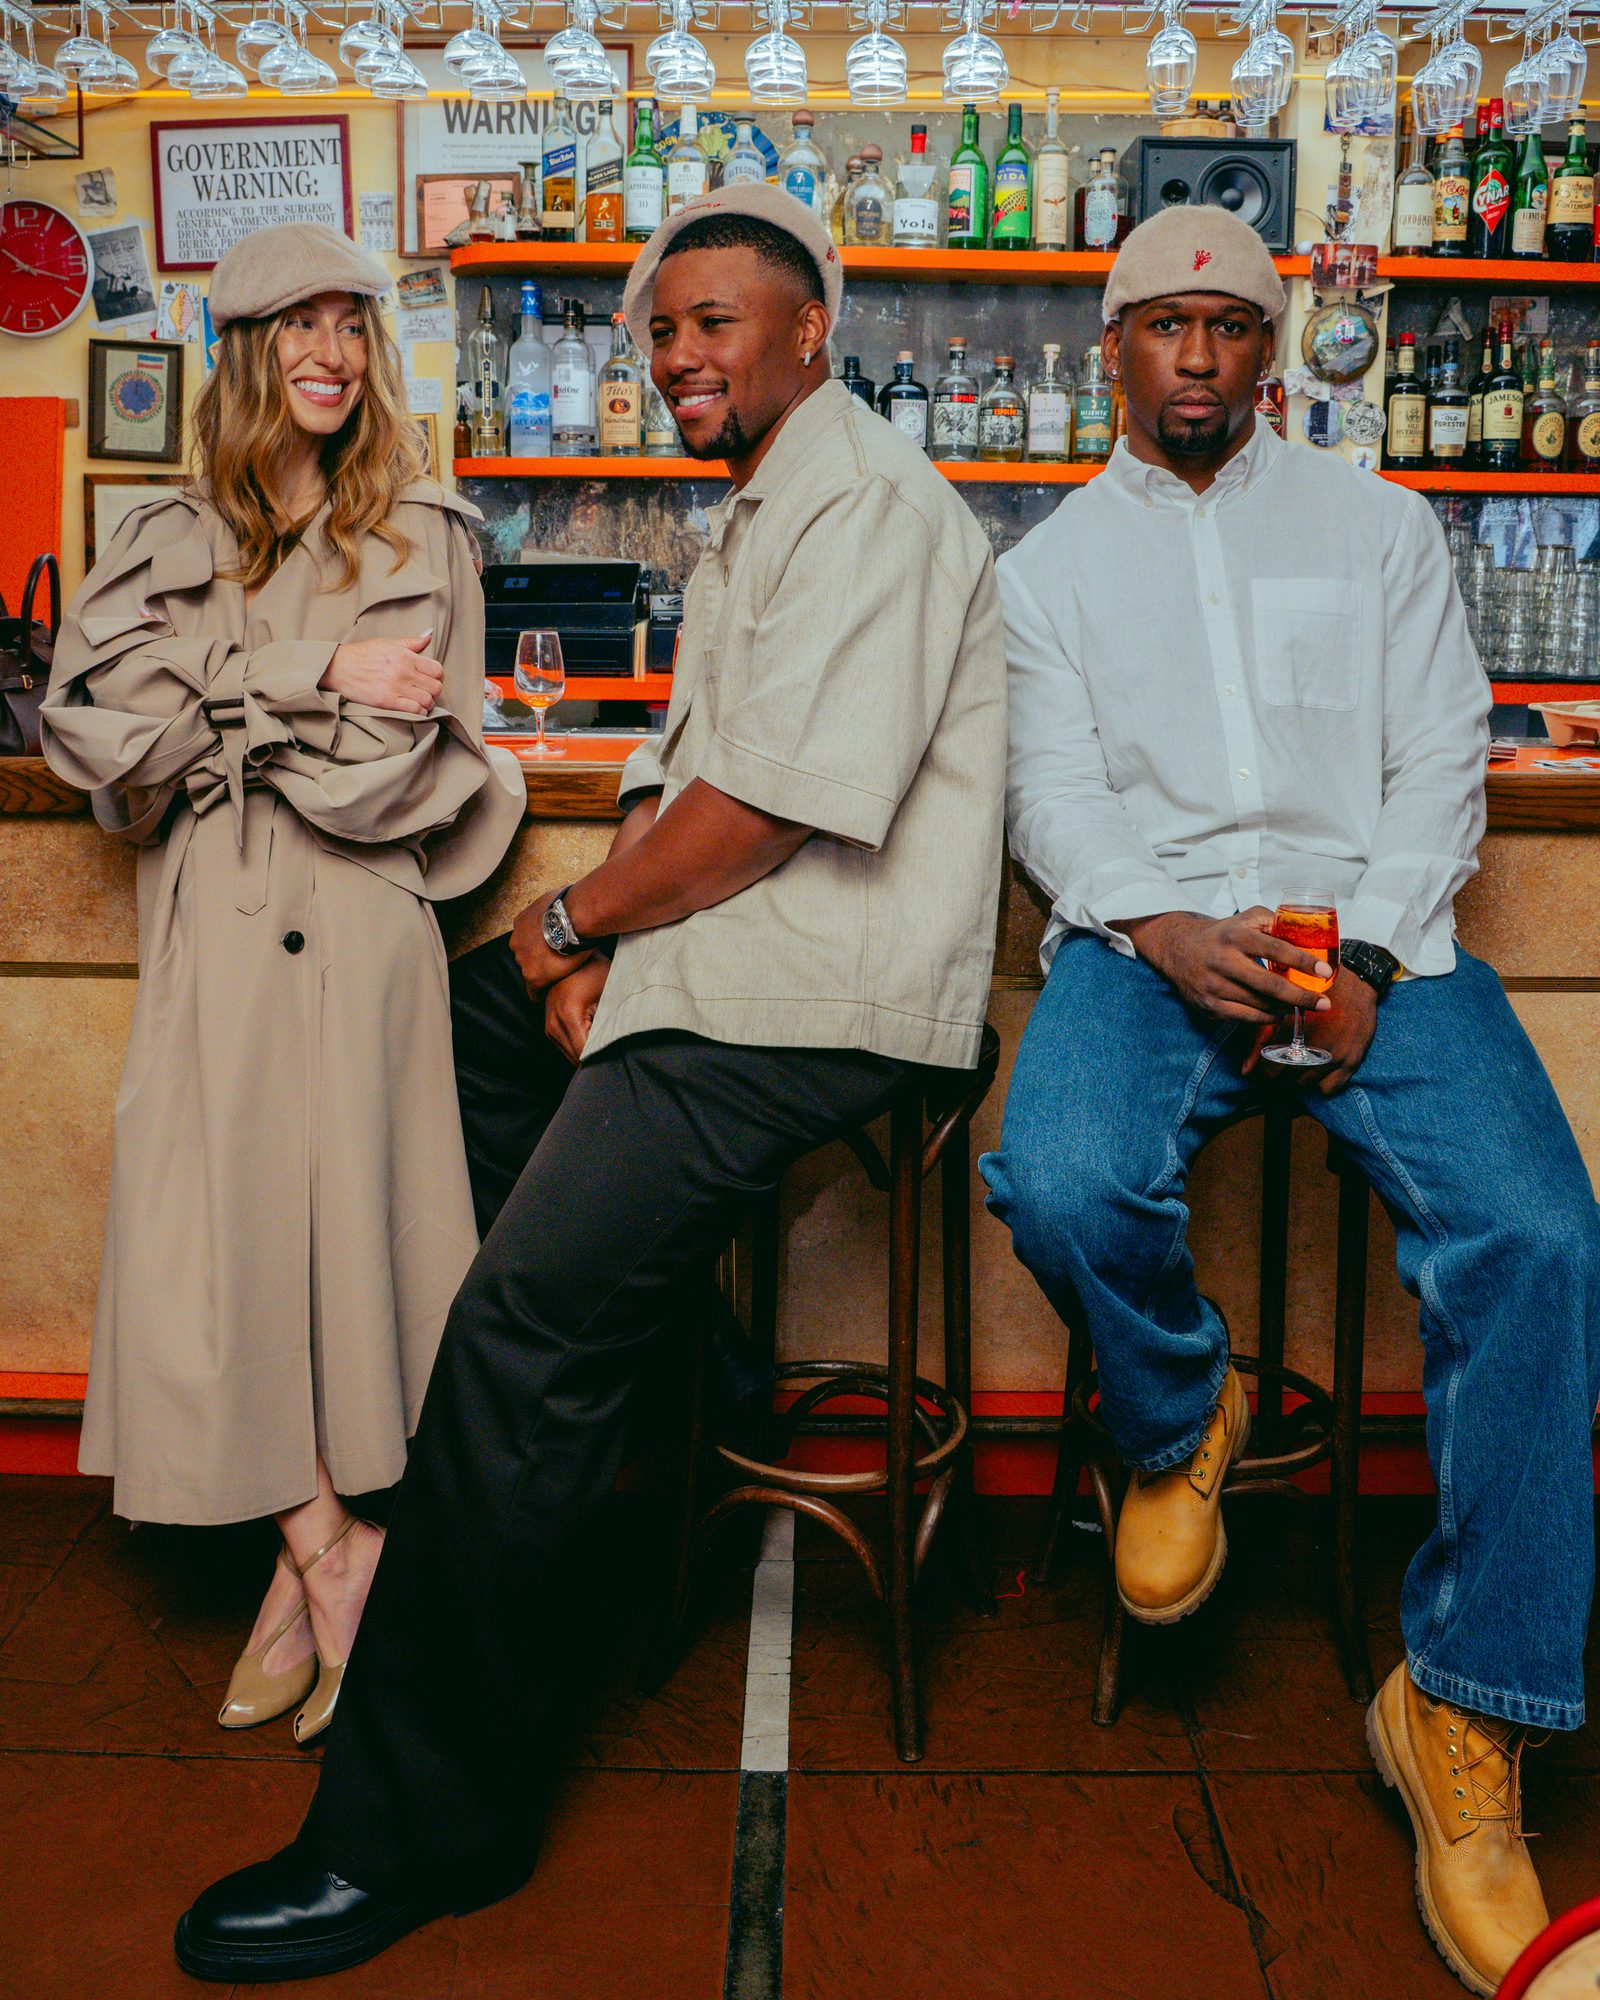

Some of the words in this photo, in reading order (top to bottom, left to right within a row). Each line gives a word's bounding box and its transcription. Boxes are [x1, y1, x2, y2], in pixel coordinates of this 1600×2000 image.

[167, 137, 341, 172] GOVERNMENT
[997, 173, 1025, 182] VIDA
[192, 170, 319, 202] WARNING:
[1473, 184, 1510, 213] CYNAR
[14, 207, 40, 228] 12
[176, 206, 236, 220] ACCORDING
[241, 206, 255, 216] TO
[259, 205, 279, 215] THE
[284, 202, 333, 214] SURGEON
[231, 215, 270, 227] WOMEN
[315, 212, 336, 224] NOT
[900, 218, 934, 230] Yola
[177, 229, 210, 240] DRINK
[178, 239, 218, 250] DURING
[178, 249, 193, 260] OF
[195, 248, 217, 259] THE
[67, 255, 87, 276] 3
[21, 309, 45, 330] 6
[606, 385, 633, 396] Tito's
[1434, 419, 1466, 428] FORESTER
